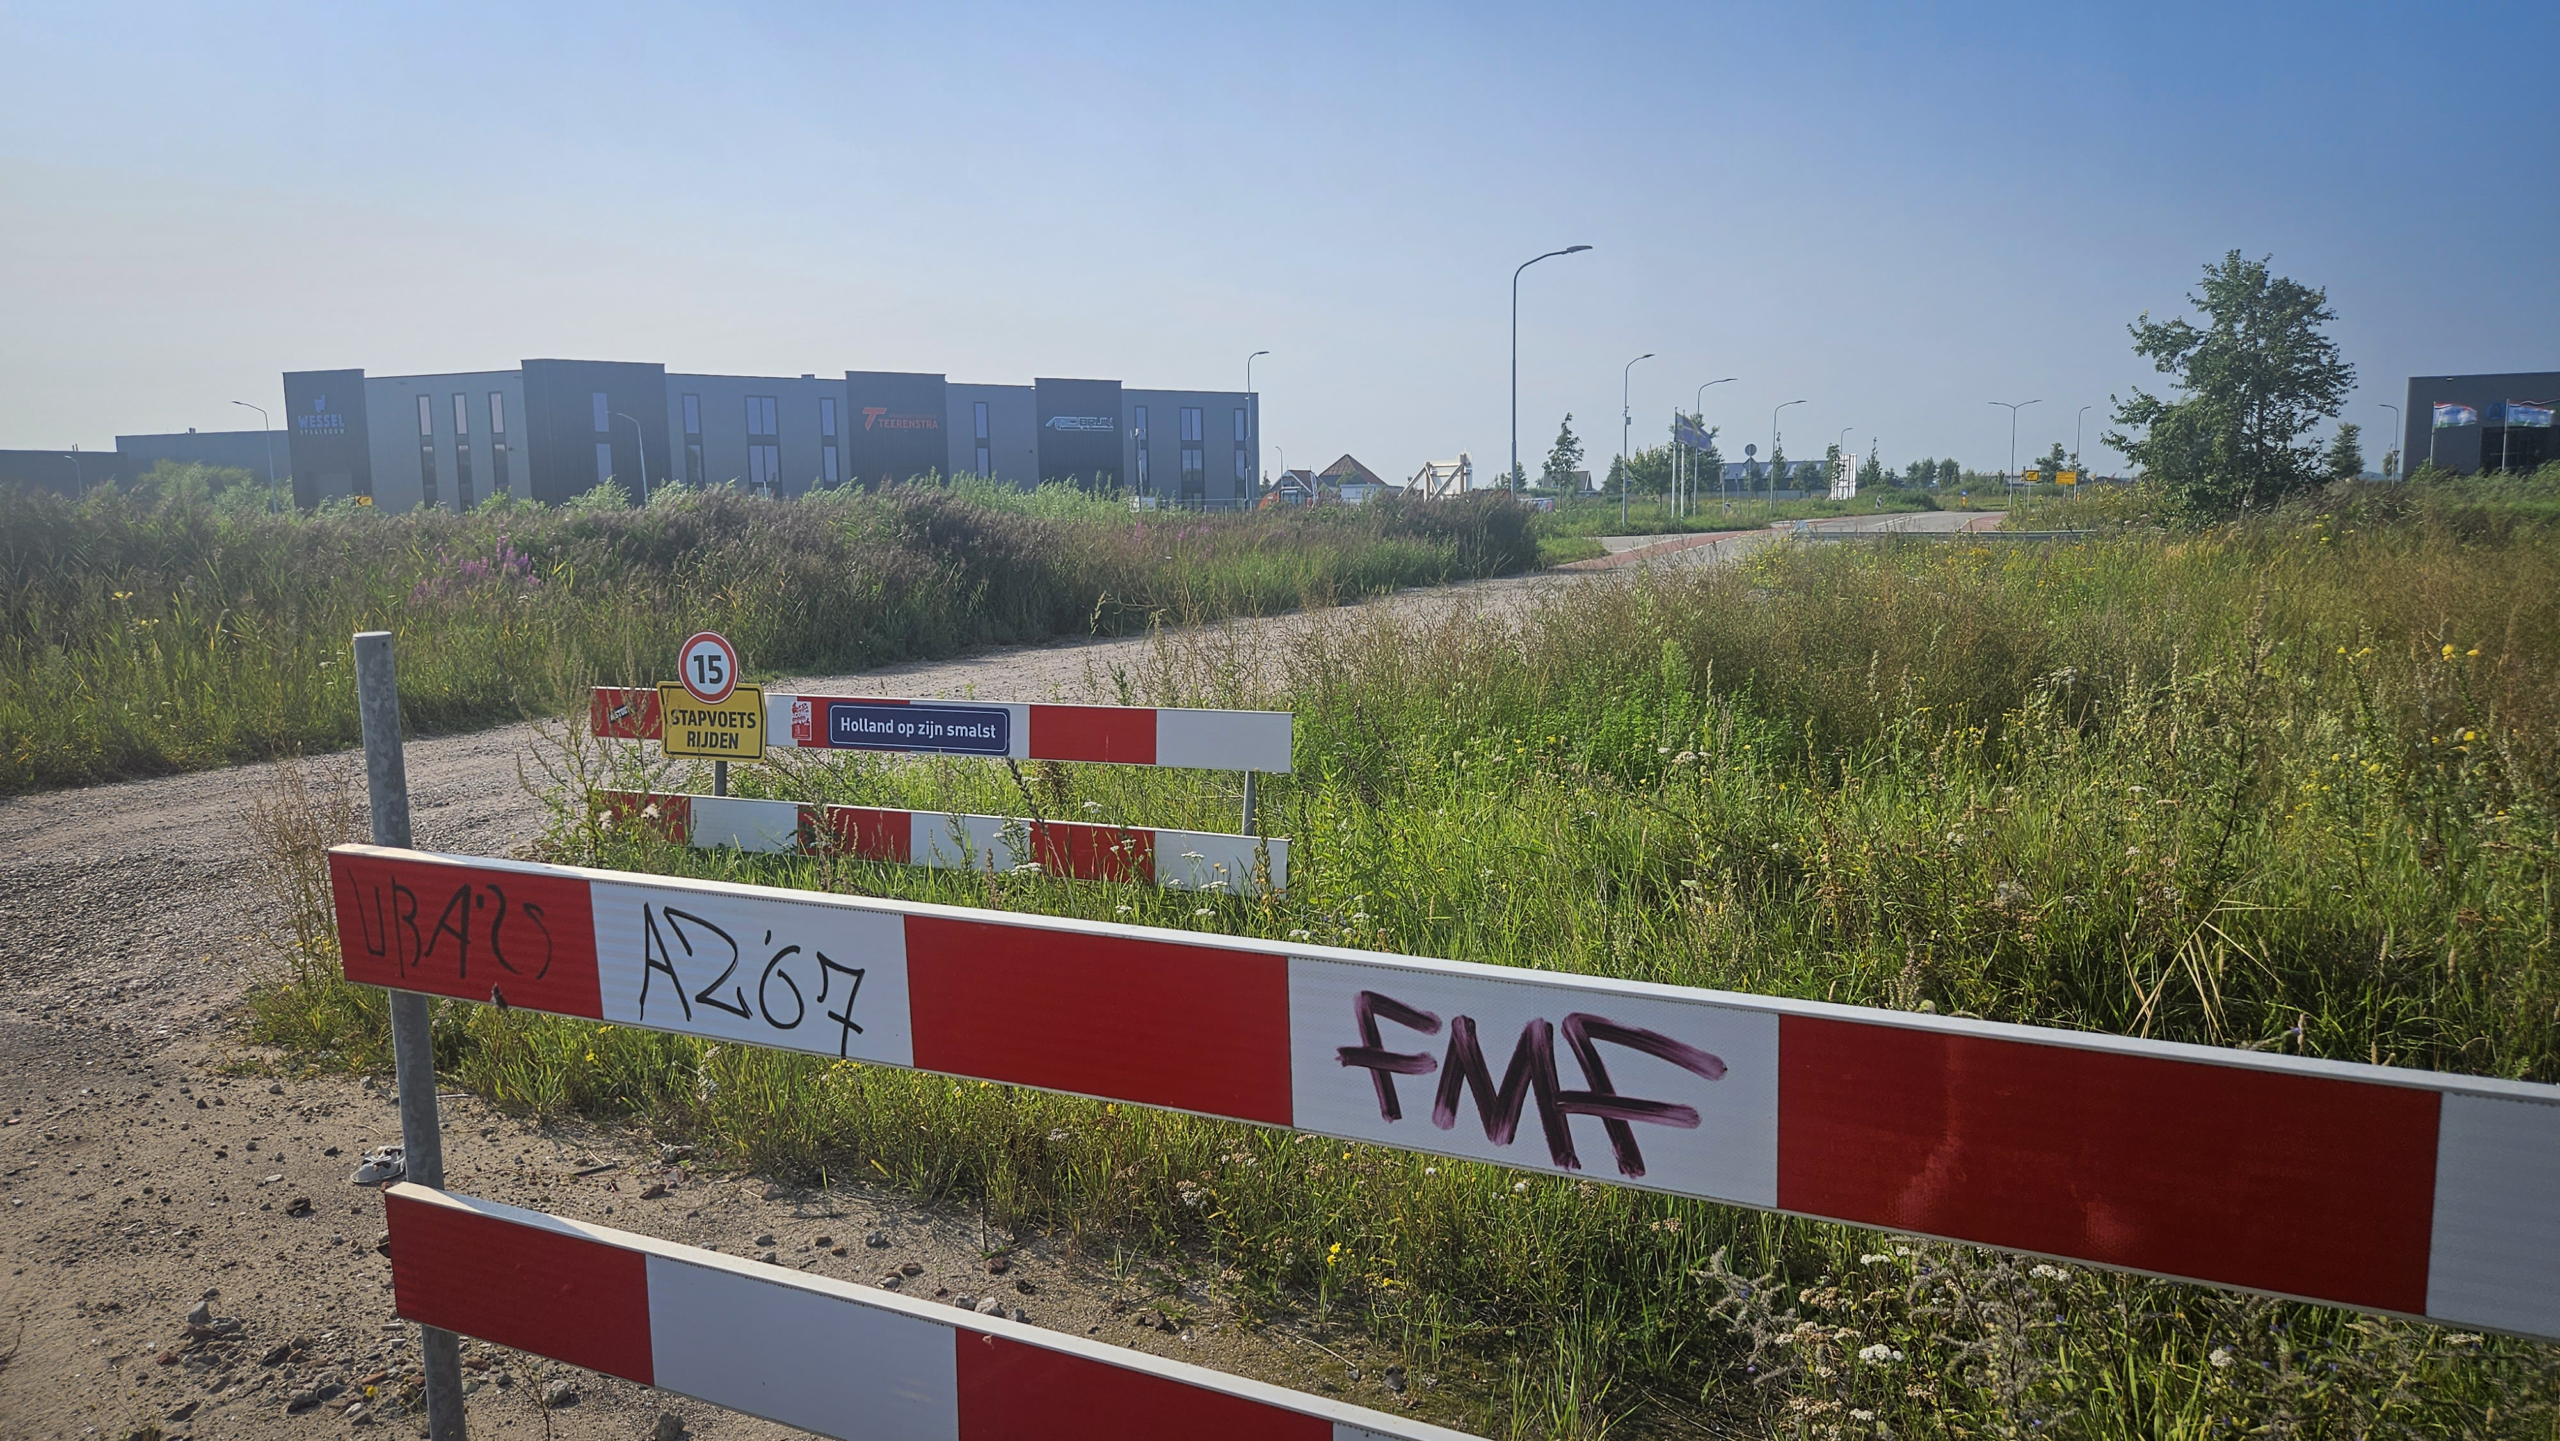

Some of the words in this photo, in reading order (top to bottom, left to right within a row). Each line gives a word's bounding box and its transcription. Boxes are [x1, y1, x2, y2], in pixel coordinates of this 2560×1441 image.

[298, 414, 345, 428] WESSEL
[878, 419, 938, 429] TEERENSTRA
[693, 655, 723, 685] 15
[670, 708, 757, 729] STAPVOETS
[840, 717, 894, 734] Holland
[897, 723, 915, 738] op
[918, 720, 943, 739] zijn
[946, 723, 996, 739] smalst
[686, 731, 739, 750] RIJDEN
[1334, 990, 1728, 1180] FMF
